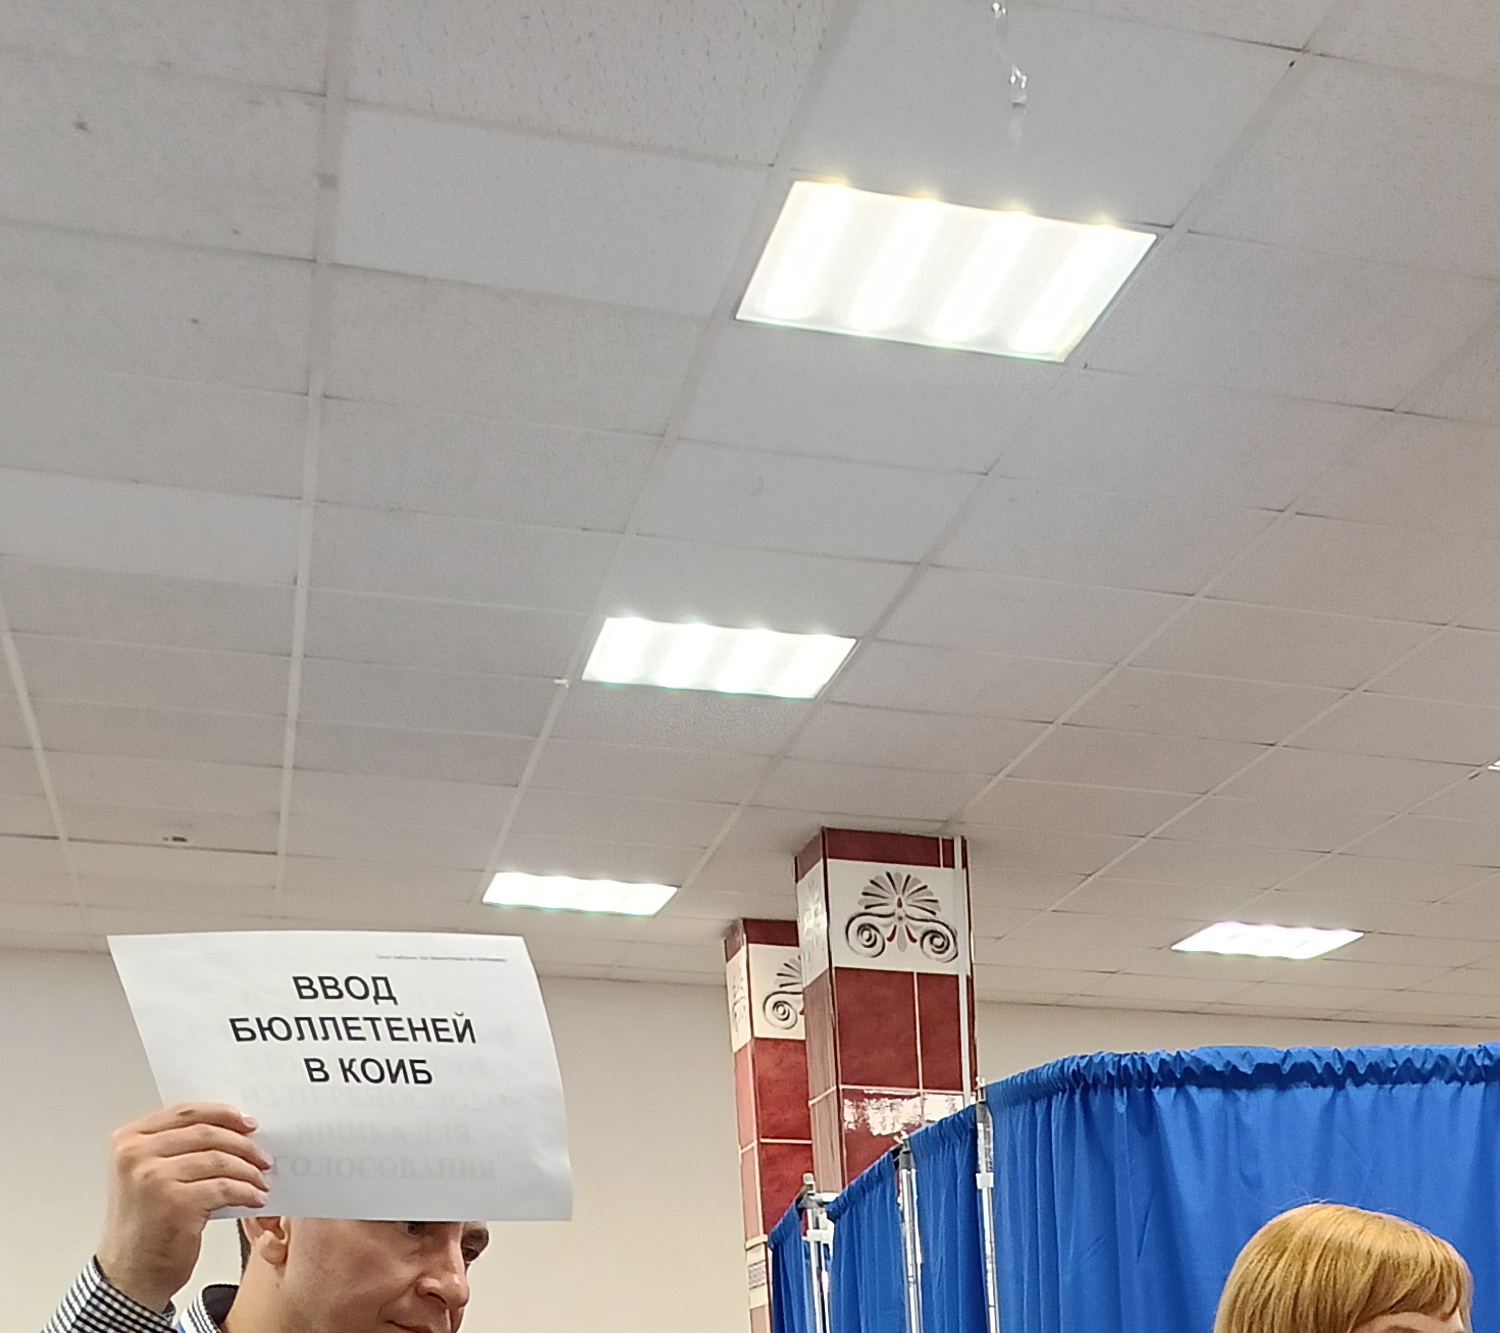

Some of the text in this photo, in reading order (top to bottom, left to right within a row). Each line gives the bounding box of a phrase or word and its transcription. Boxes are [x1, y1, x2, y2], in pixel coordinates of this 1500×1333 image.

[292, 976, 397, 1005] ВВОД
[229, 1012, 477, 1044] БЮЛЛЕТЕНЕЙ
[304, 1058, 330, 1083] В
[338, 1058, 434, 1085] КОИБ
